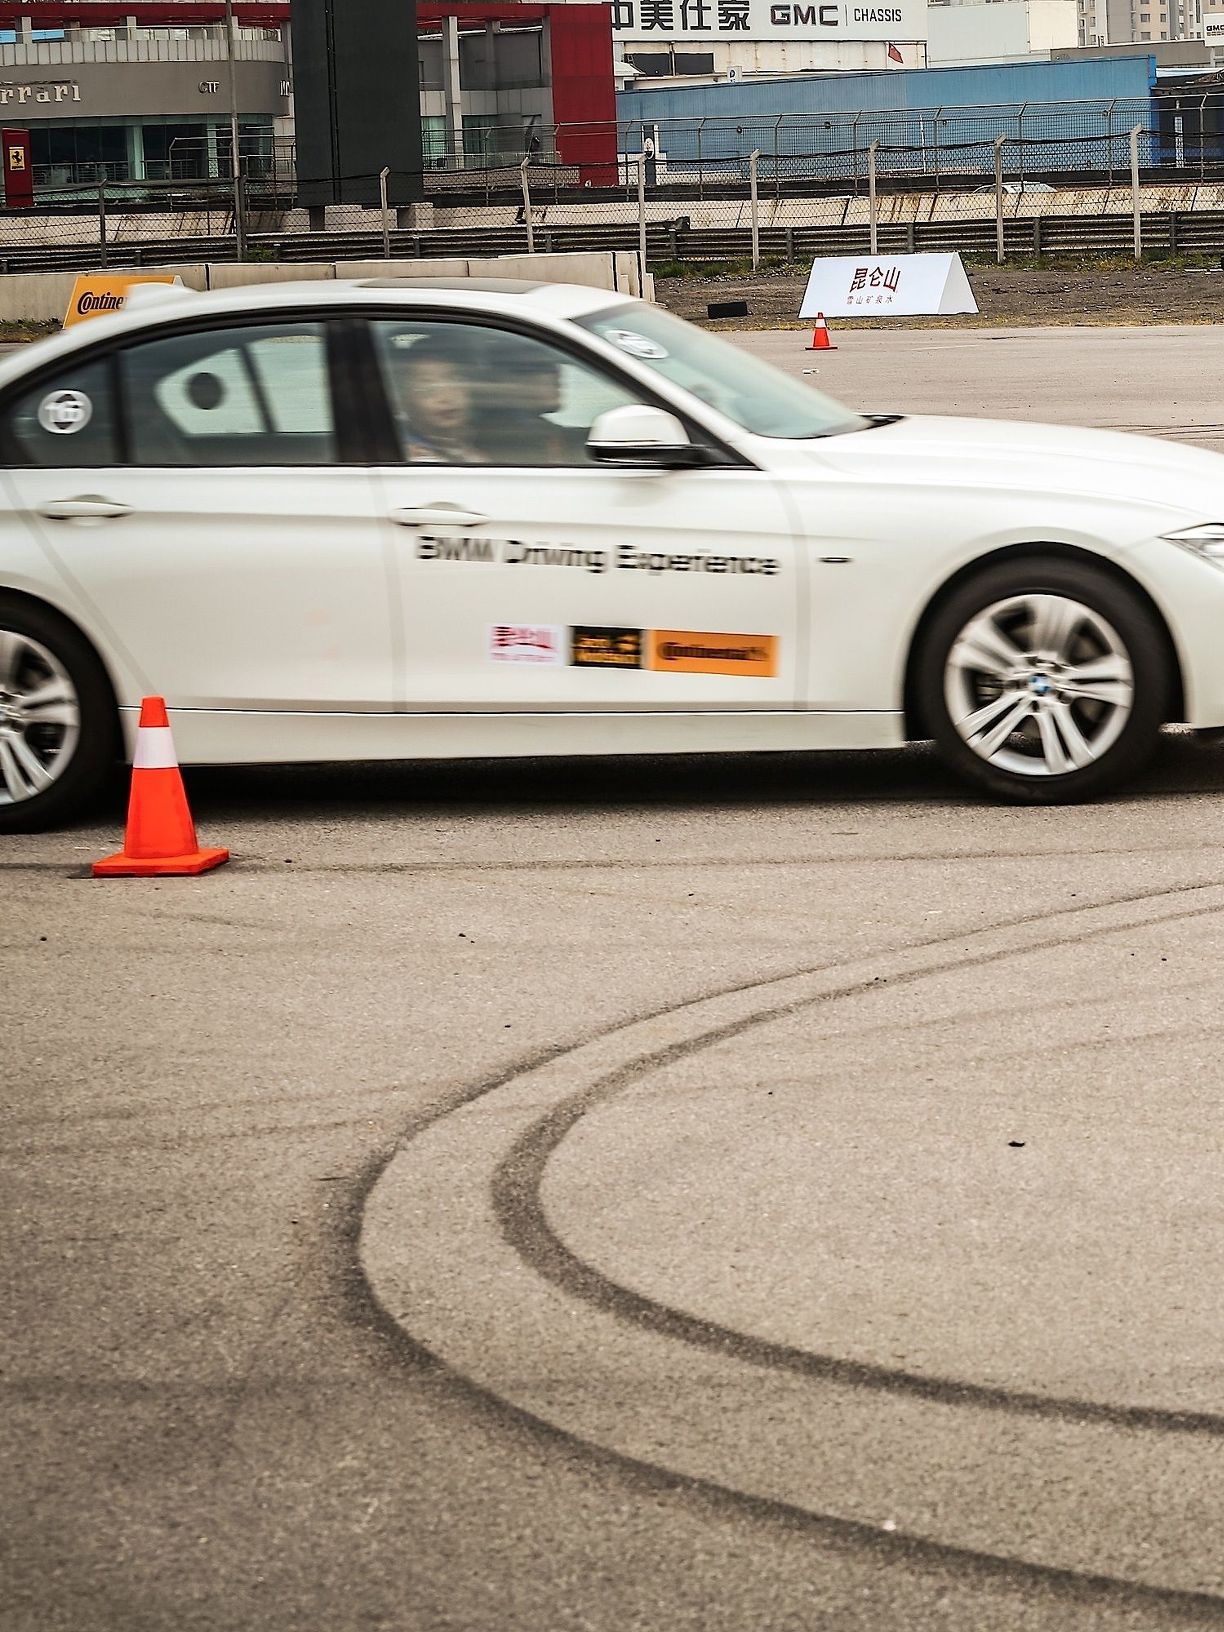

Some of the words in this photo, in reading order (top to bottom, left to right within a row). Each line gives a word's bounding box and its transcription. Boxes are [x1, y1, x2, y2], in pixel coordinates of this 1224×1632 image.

[612, 0, 751, 31] 中美仕家
[770, 3, 839, 27] GMC
[854, 8, 902, 22] CHASSIS
[0, 84, 81, 104] rrari
[199, 81, 219, 93] CTF
[849, 266, 901, 292] 昆仑山
[77, 291, 127, 315] Contine
[417, 535, 497, 562] BMW
[502, 539, 608, 575] Driving
[614, 544, 781, 576] Experience
